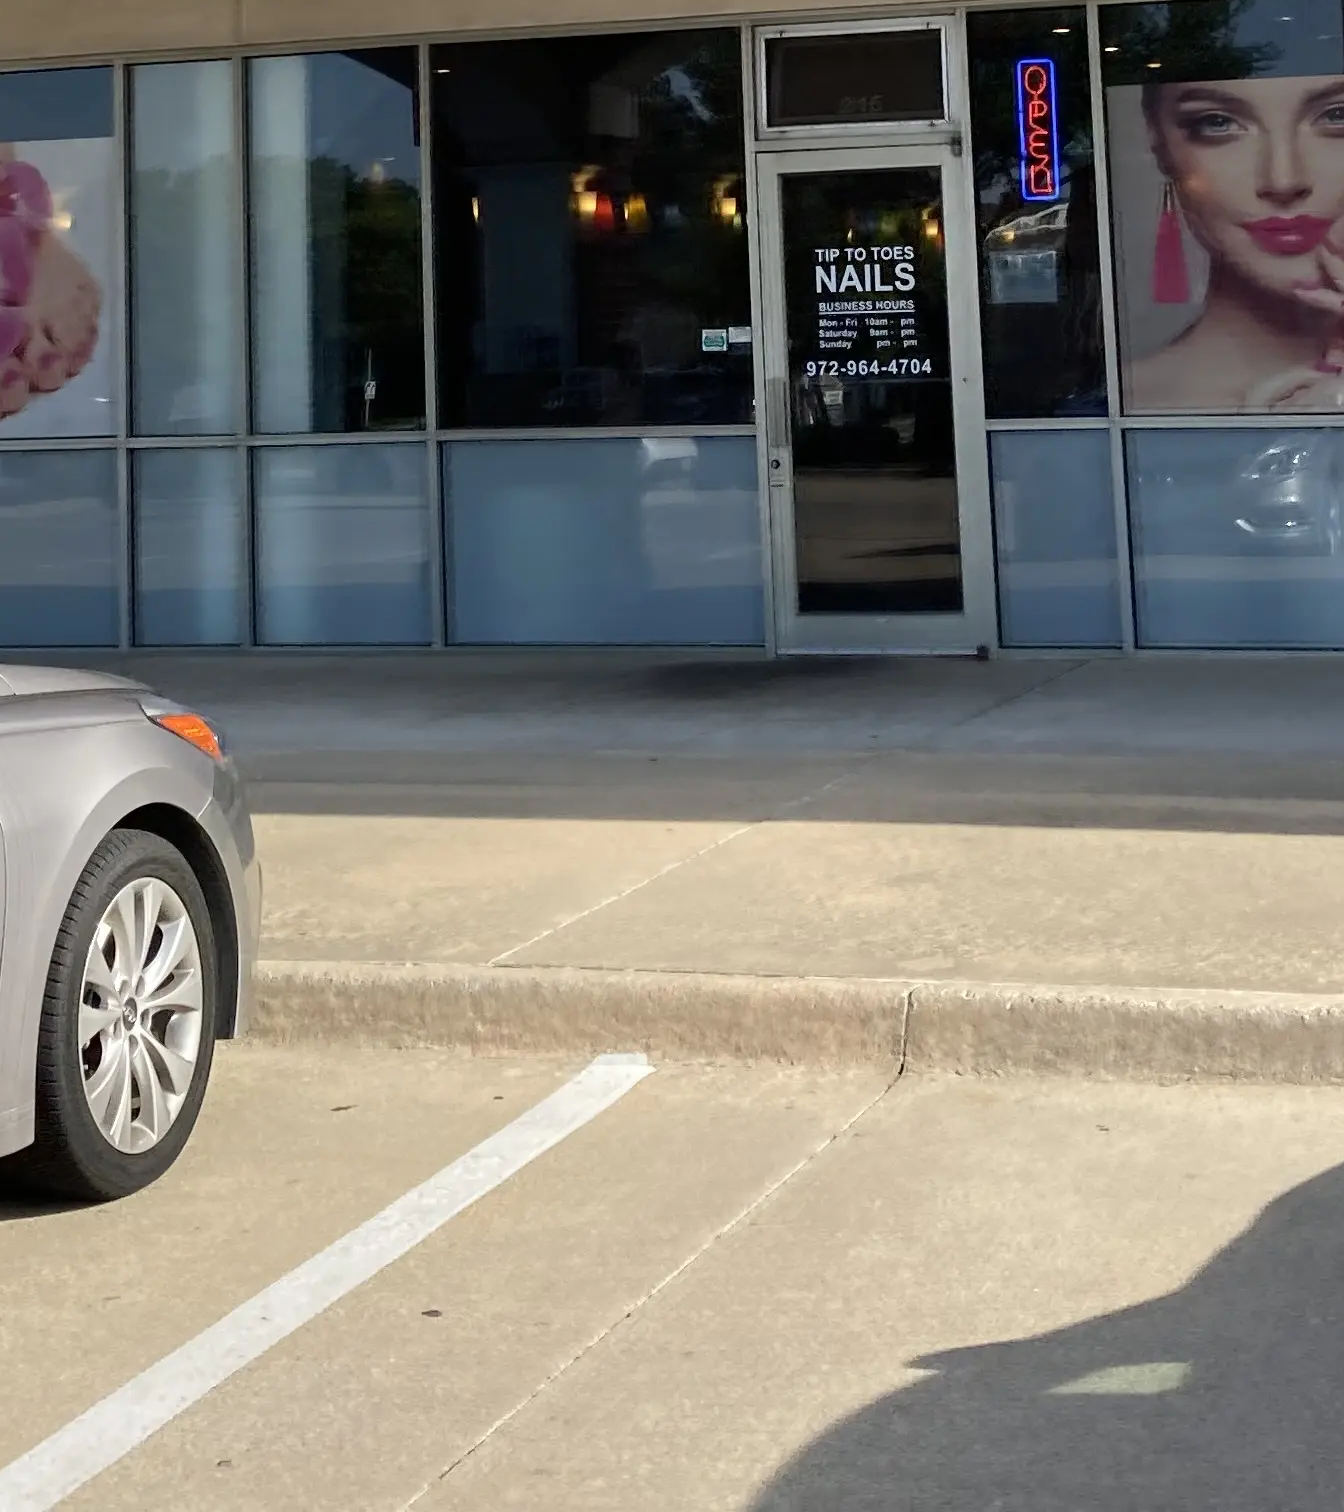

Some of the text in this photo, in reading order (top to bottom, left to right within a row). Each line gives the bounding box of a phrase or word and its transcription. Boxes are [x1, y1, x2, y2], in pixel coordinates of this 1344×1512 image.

[1024, 65, 1052, 194] OPEN
[815, 246, 915, 263] TIP TO TOES
[815, 262, 916, 294] NAILS
[818, 299, 915, 312] BUSINESS HOURS
[819, 318, 838, 327] Mon
[845, 318, 858, 327] Fri
[900, 318, 915, 327] pm
[818, 329, 858, 339] Saturday
[900, 328, 915, 338] pm
[819, 340, 853, 350] Sunday
[903, 339, 918, 348] pm
[806, 358, 932, 377] 972-964-4704
